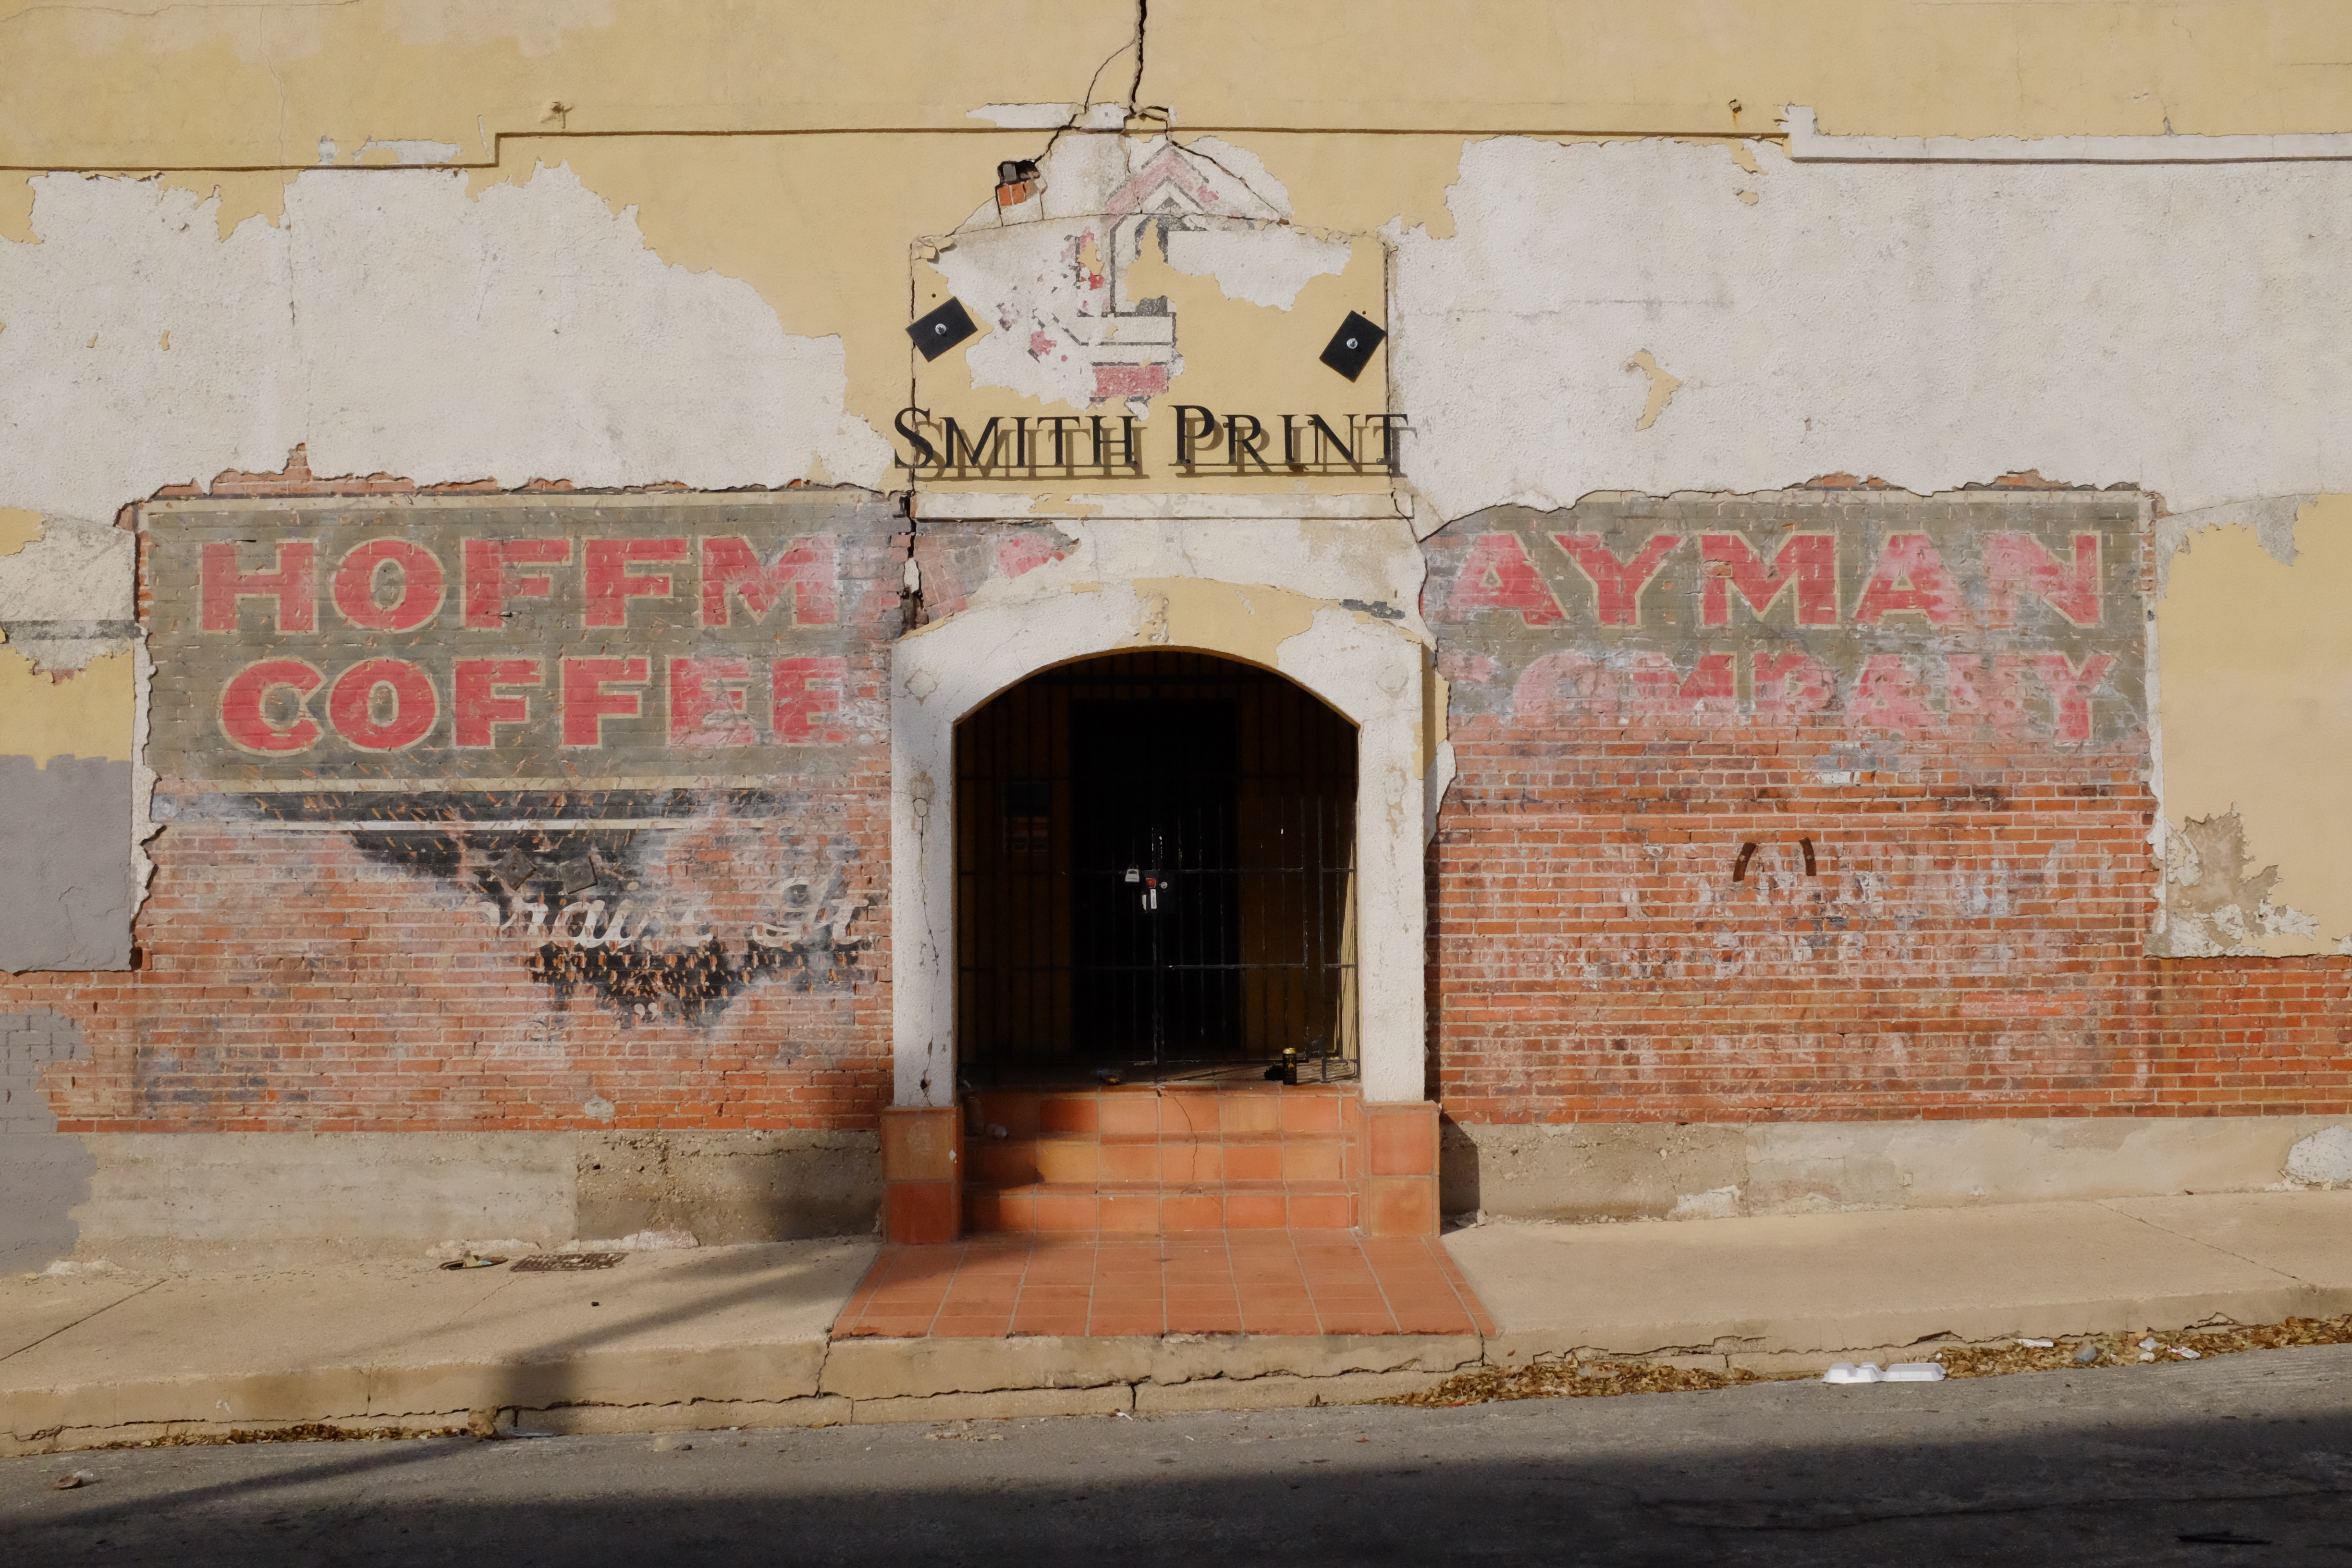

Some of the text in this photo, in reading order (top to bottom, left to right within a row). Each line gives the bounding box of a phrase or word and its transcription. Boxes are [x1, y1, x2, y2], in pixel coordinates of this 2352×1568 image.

[894, 405, 1408, 469] SMITH PRINT
[219, 657, 844, 753] COFFEE
